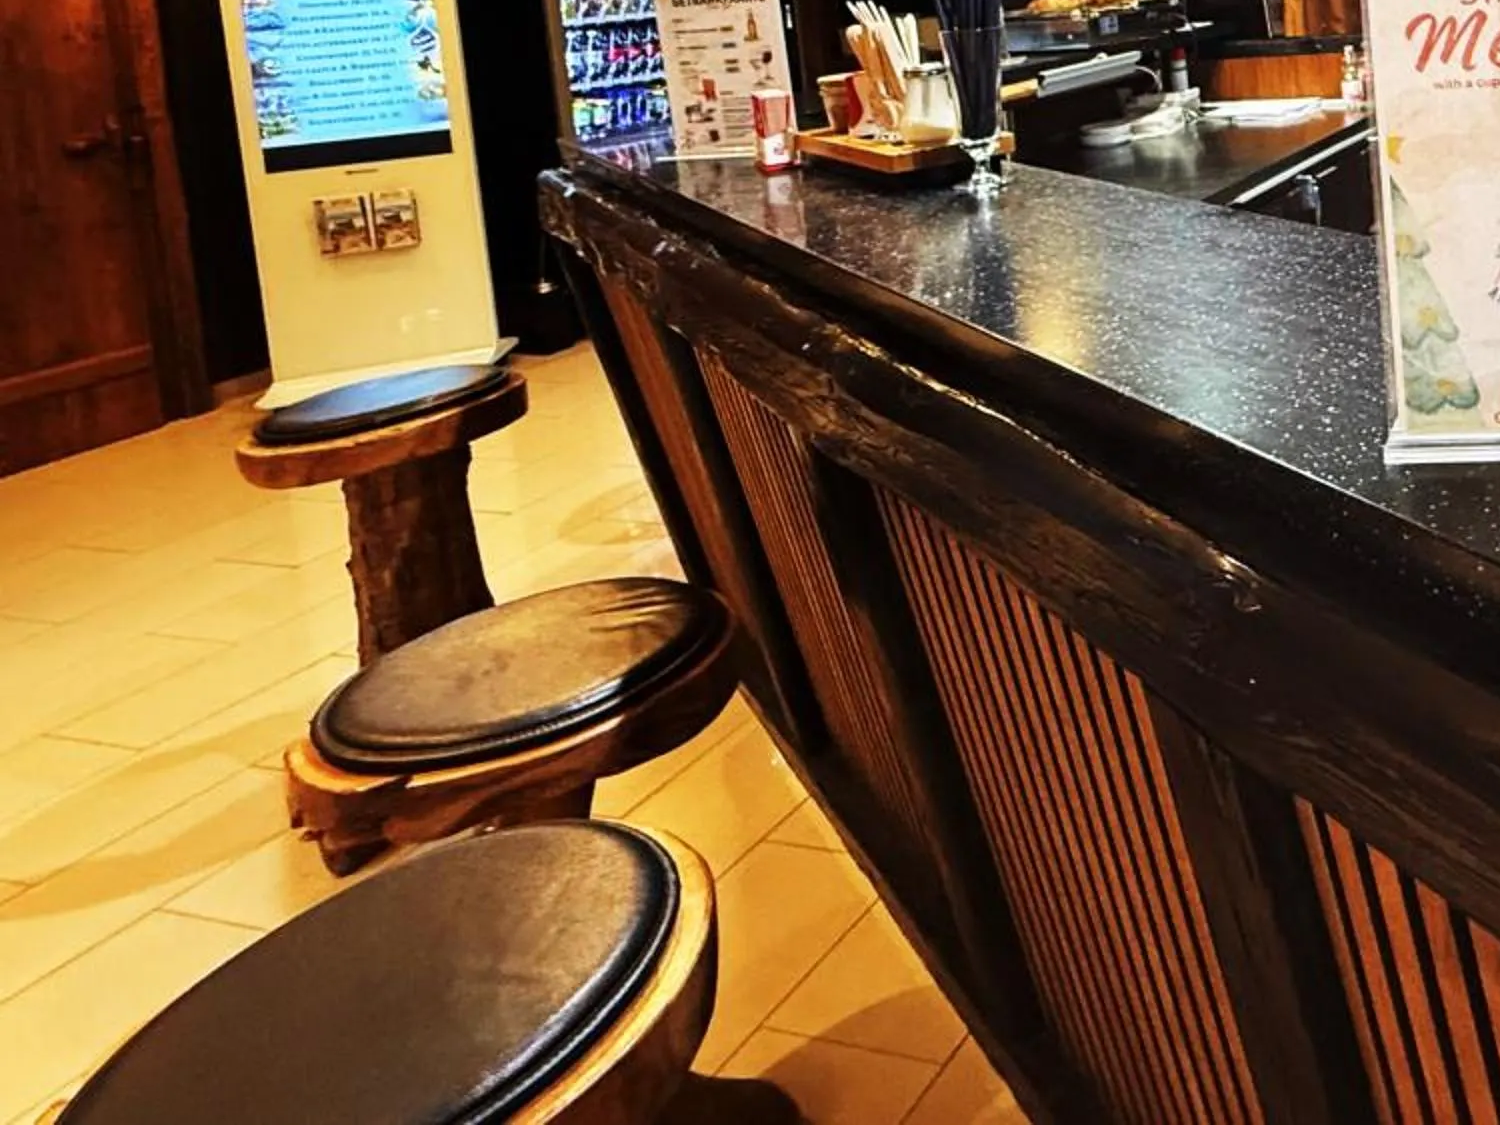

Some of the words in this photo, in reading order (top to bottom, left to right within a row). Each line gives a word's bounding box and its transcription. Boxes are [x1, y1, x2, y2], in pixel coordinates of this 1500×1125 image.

[1433, 78, 1462, 90] with
[1465, 80, 1473, 89] a
[1477, 78, 1500, 90] cup
